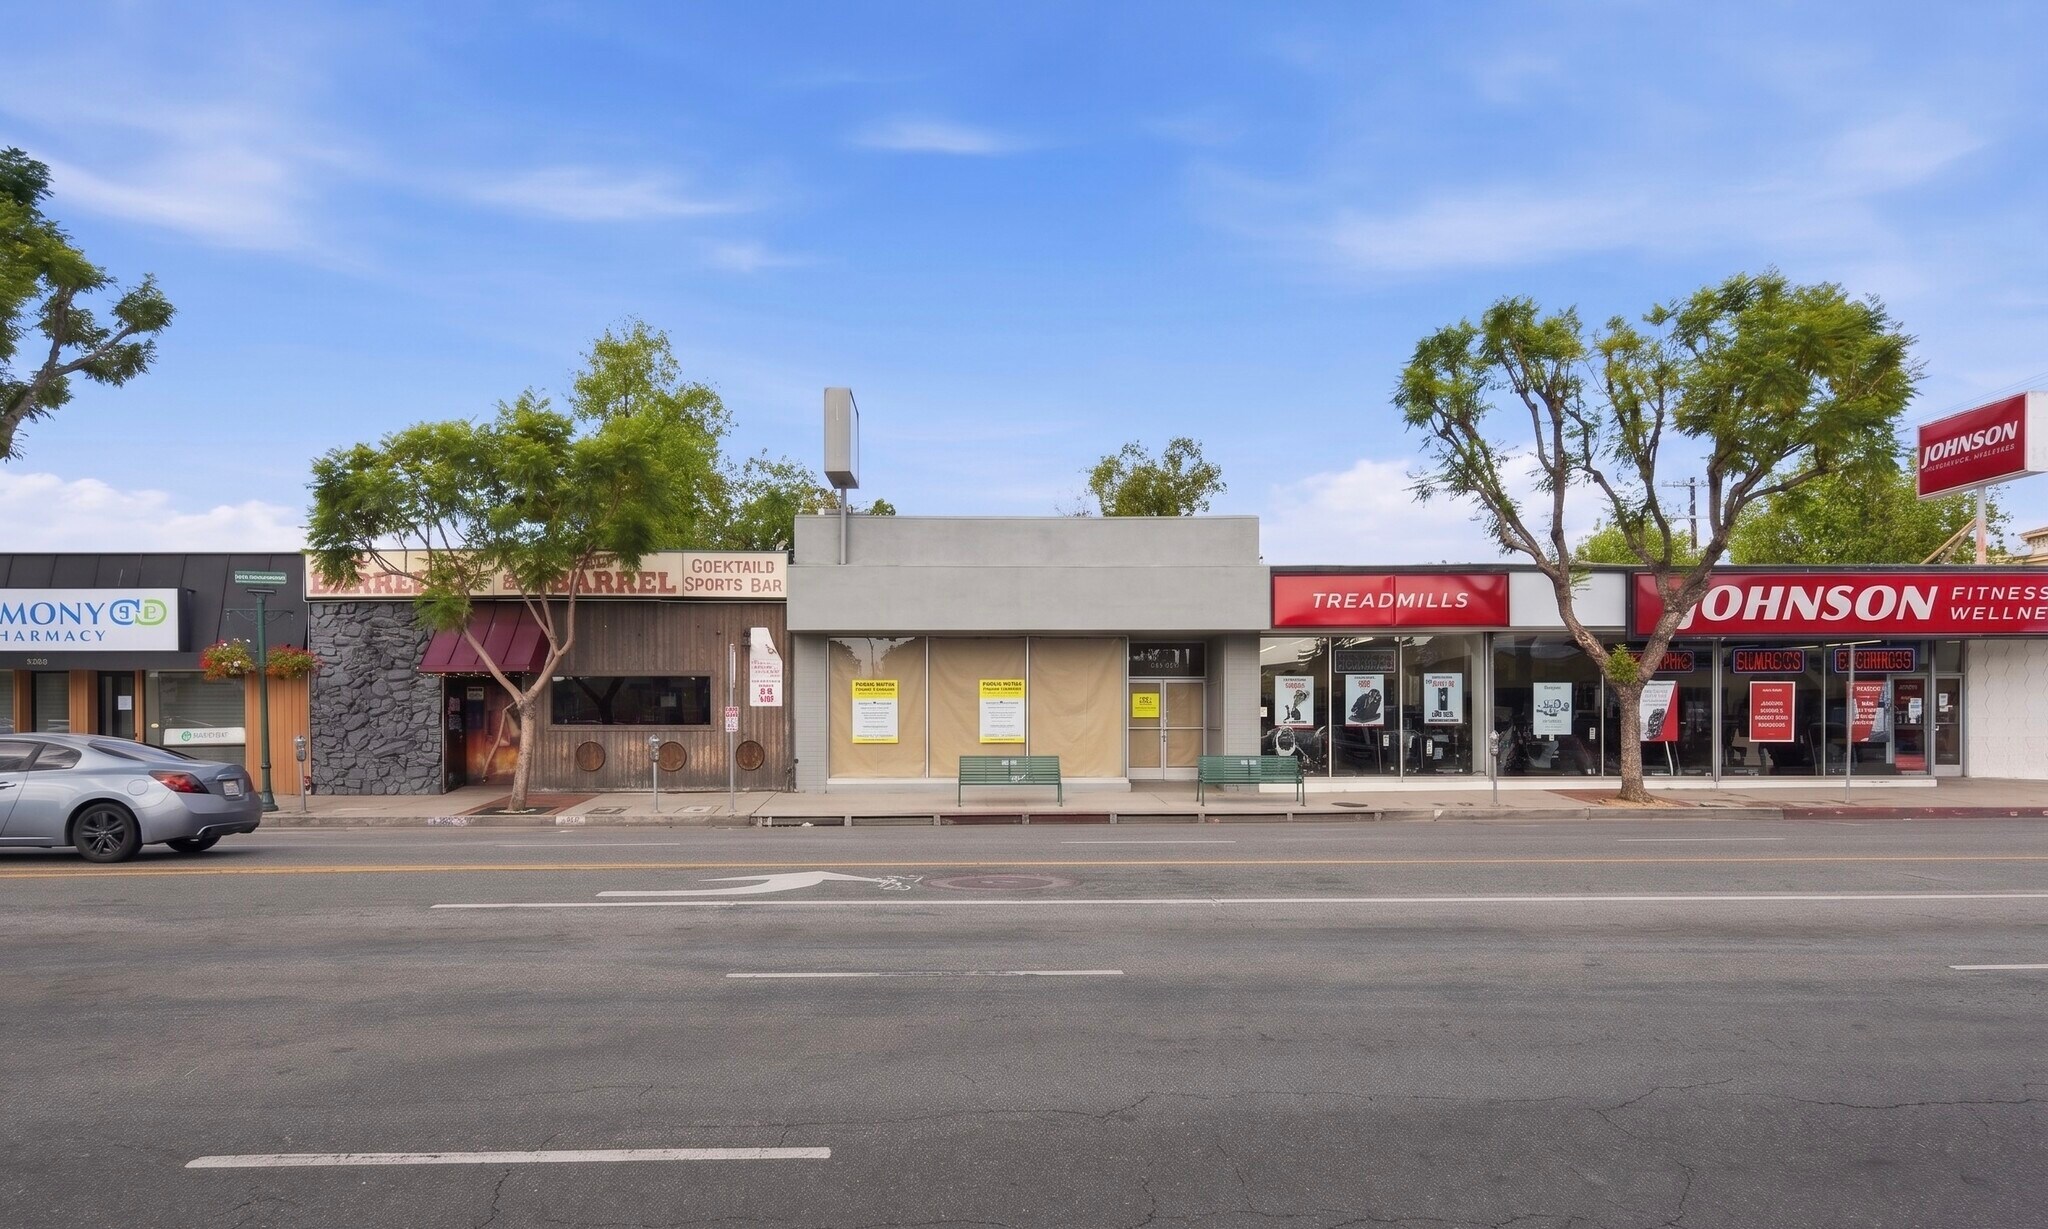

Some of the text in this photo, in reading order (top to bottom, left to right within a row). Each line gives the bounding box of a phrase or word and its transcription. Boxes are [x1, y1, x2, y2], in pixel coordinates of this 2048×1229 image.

[1921, 421, 2018, 469] JOHNSON
[310, 570, 677, 594] BRRE BARREL
[684, 576, 783, 593] SPORTS BAR
[1312, 592, 1469, 609] TREADMILLS
[1951, 586, 2048, 600] FITNESS
[1950, 606, 2048, 620] WELLNE
